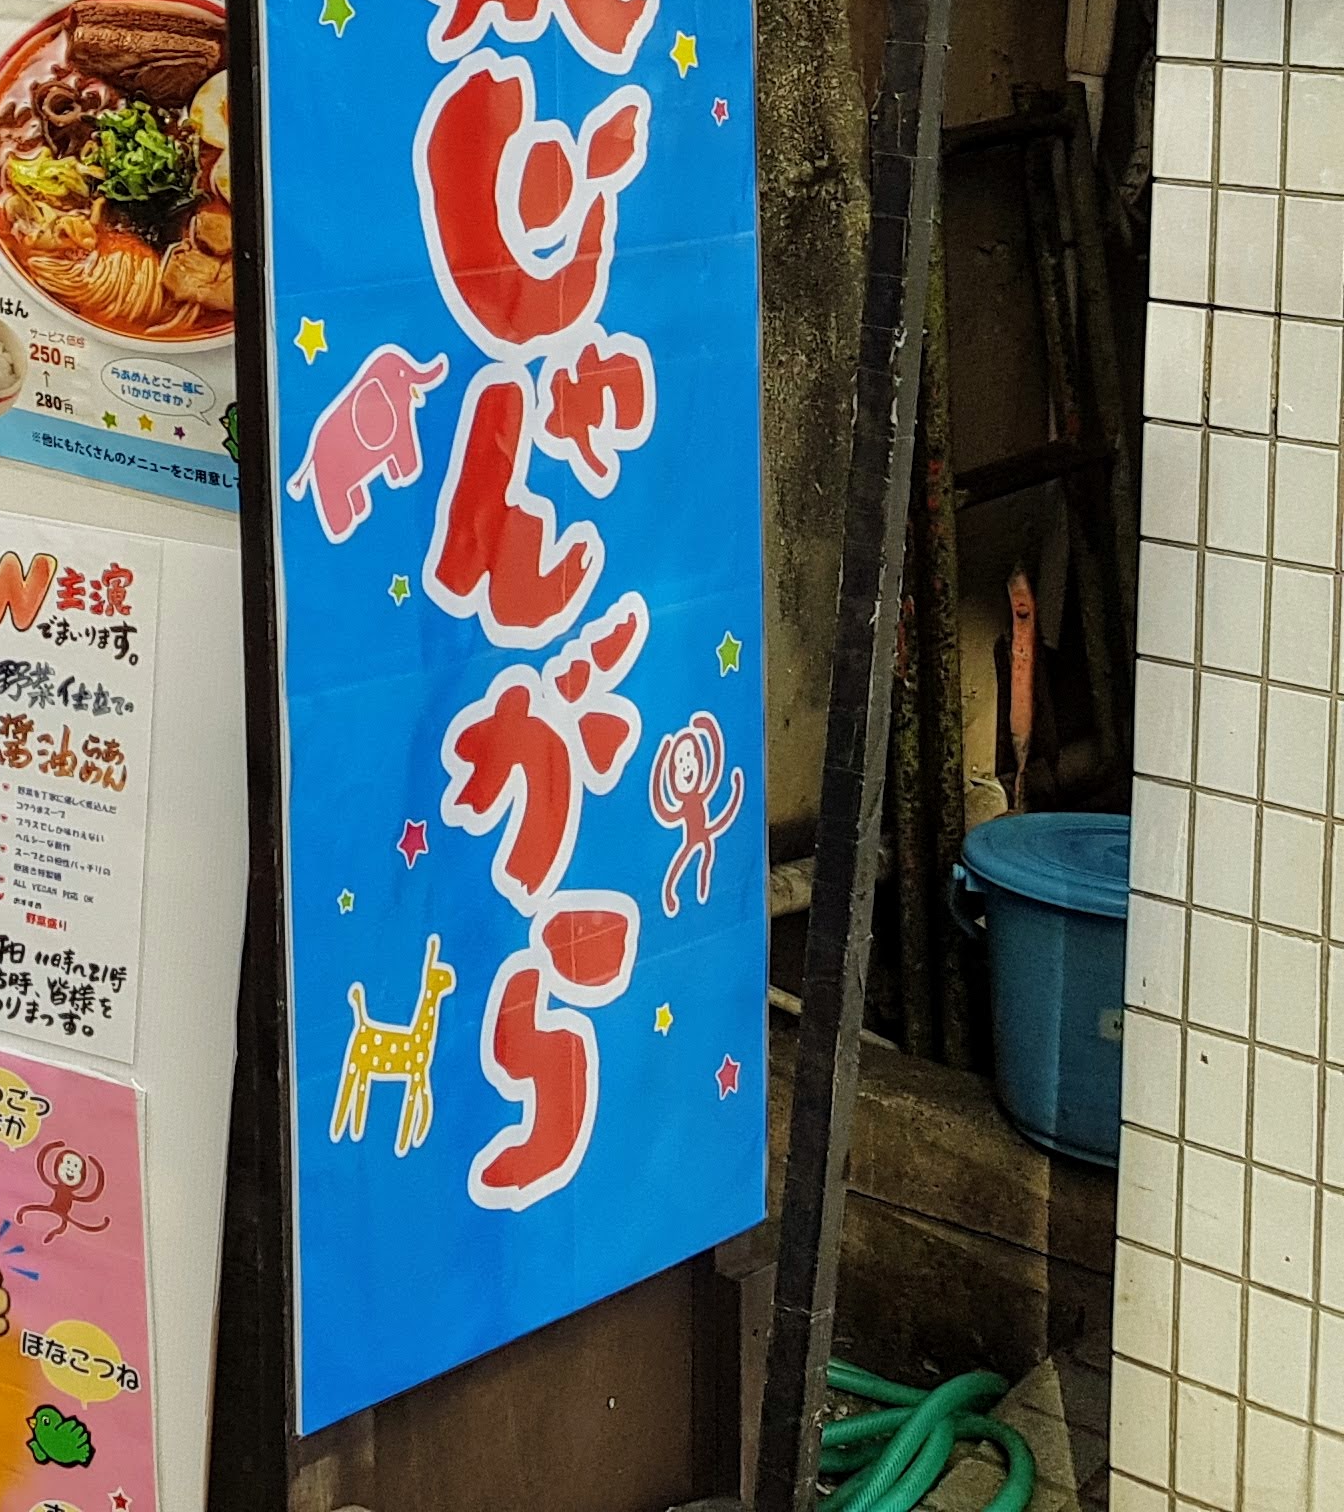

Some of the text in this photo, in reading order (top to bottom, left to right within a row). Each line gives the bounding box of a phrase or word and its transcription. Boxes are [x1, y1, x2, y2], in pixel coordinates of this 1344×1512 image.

[56, 563, 134, 616] 主演
[20, 1329, 140, 1392] ほなこつね
